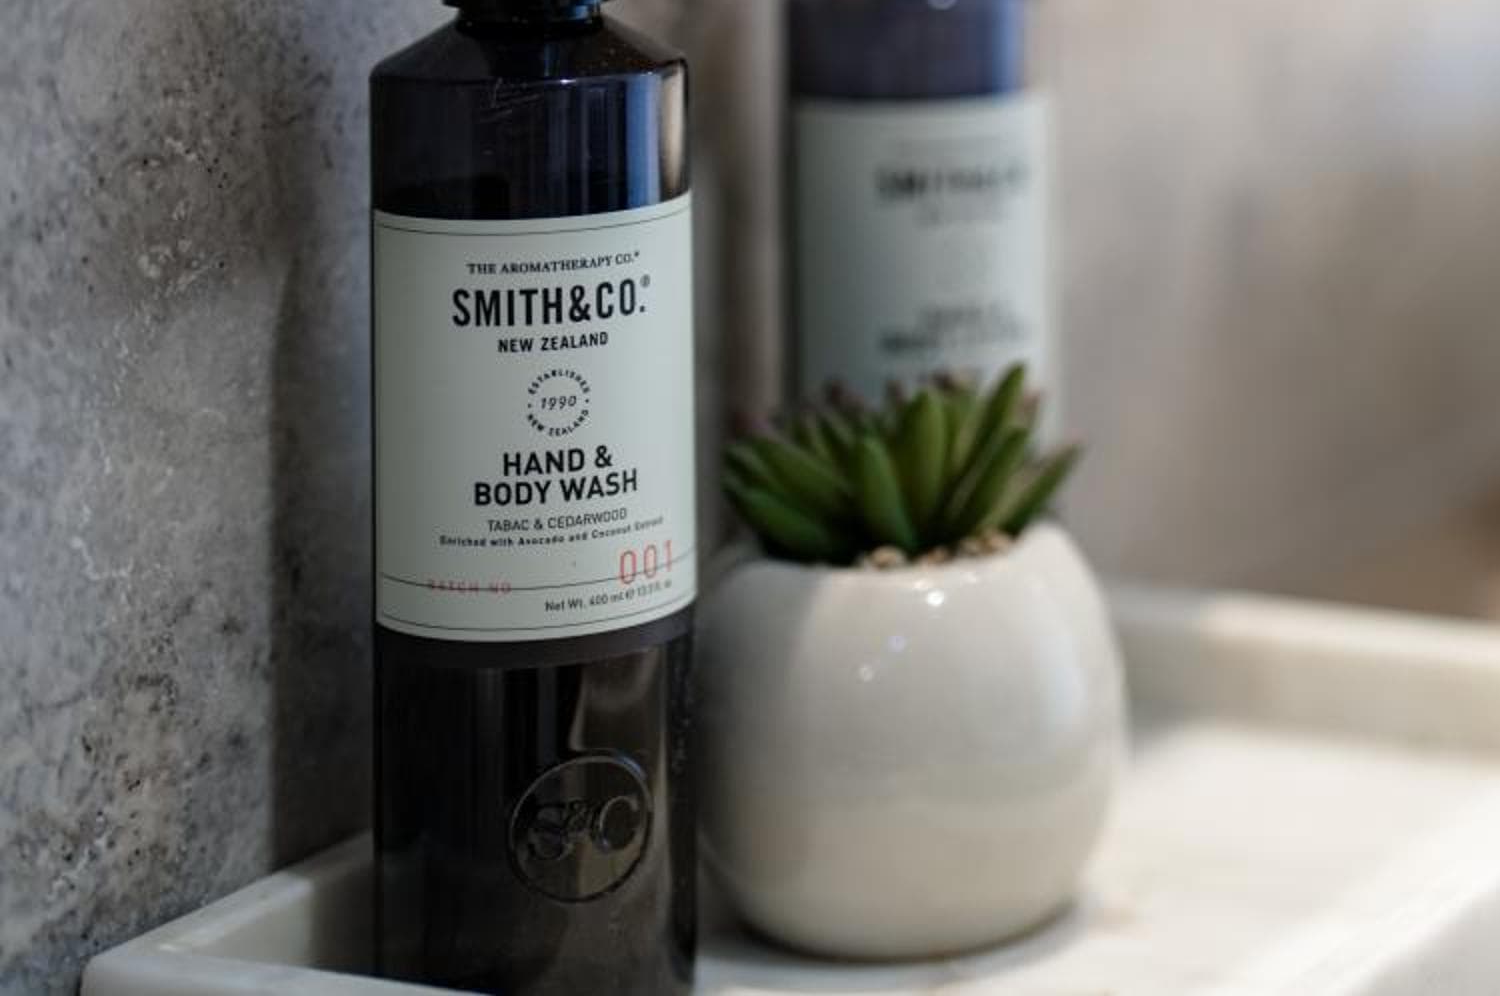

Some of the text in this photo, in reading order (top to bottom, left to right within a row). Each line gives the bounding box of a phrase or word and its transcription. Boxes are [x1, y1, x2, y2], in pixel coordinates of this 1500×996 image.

[466, 263, 496, 274] THE
[501, 254, 612, 274] AROMATHERAPY
[498, 331, 609, 353] NEW ZEALAND
[541, 395, 577, 410] 1990
[503, 445, 613, 477] HAND &
[474, 468, 638, 506] BODY WASH
[487, 507, 627, 532] TABAC & CEDARWOOD
[440, 535, 487, 547] Enriched
[490, 537, 514, 547] with
[518, 533, 565, 547] Avocado
[568, 531, 588, 543] and
[591, 523, 631, 539] Coconut
[620, 539, 672, 585] 001
